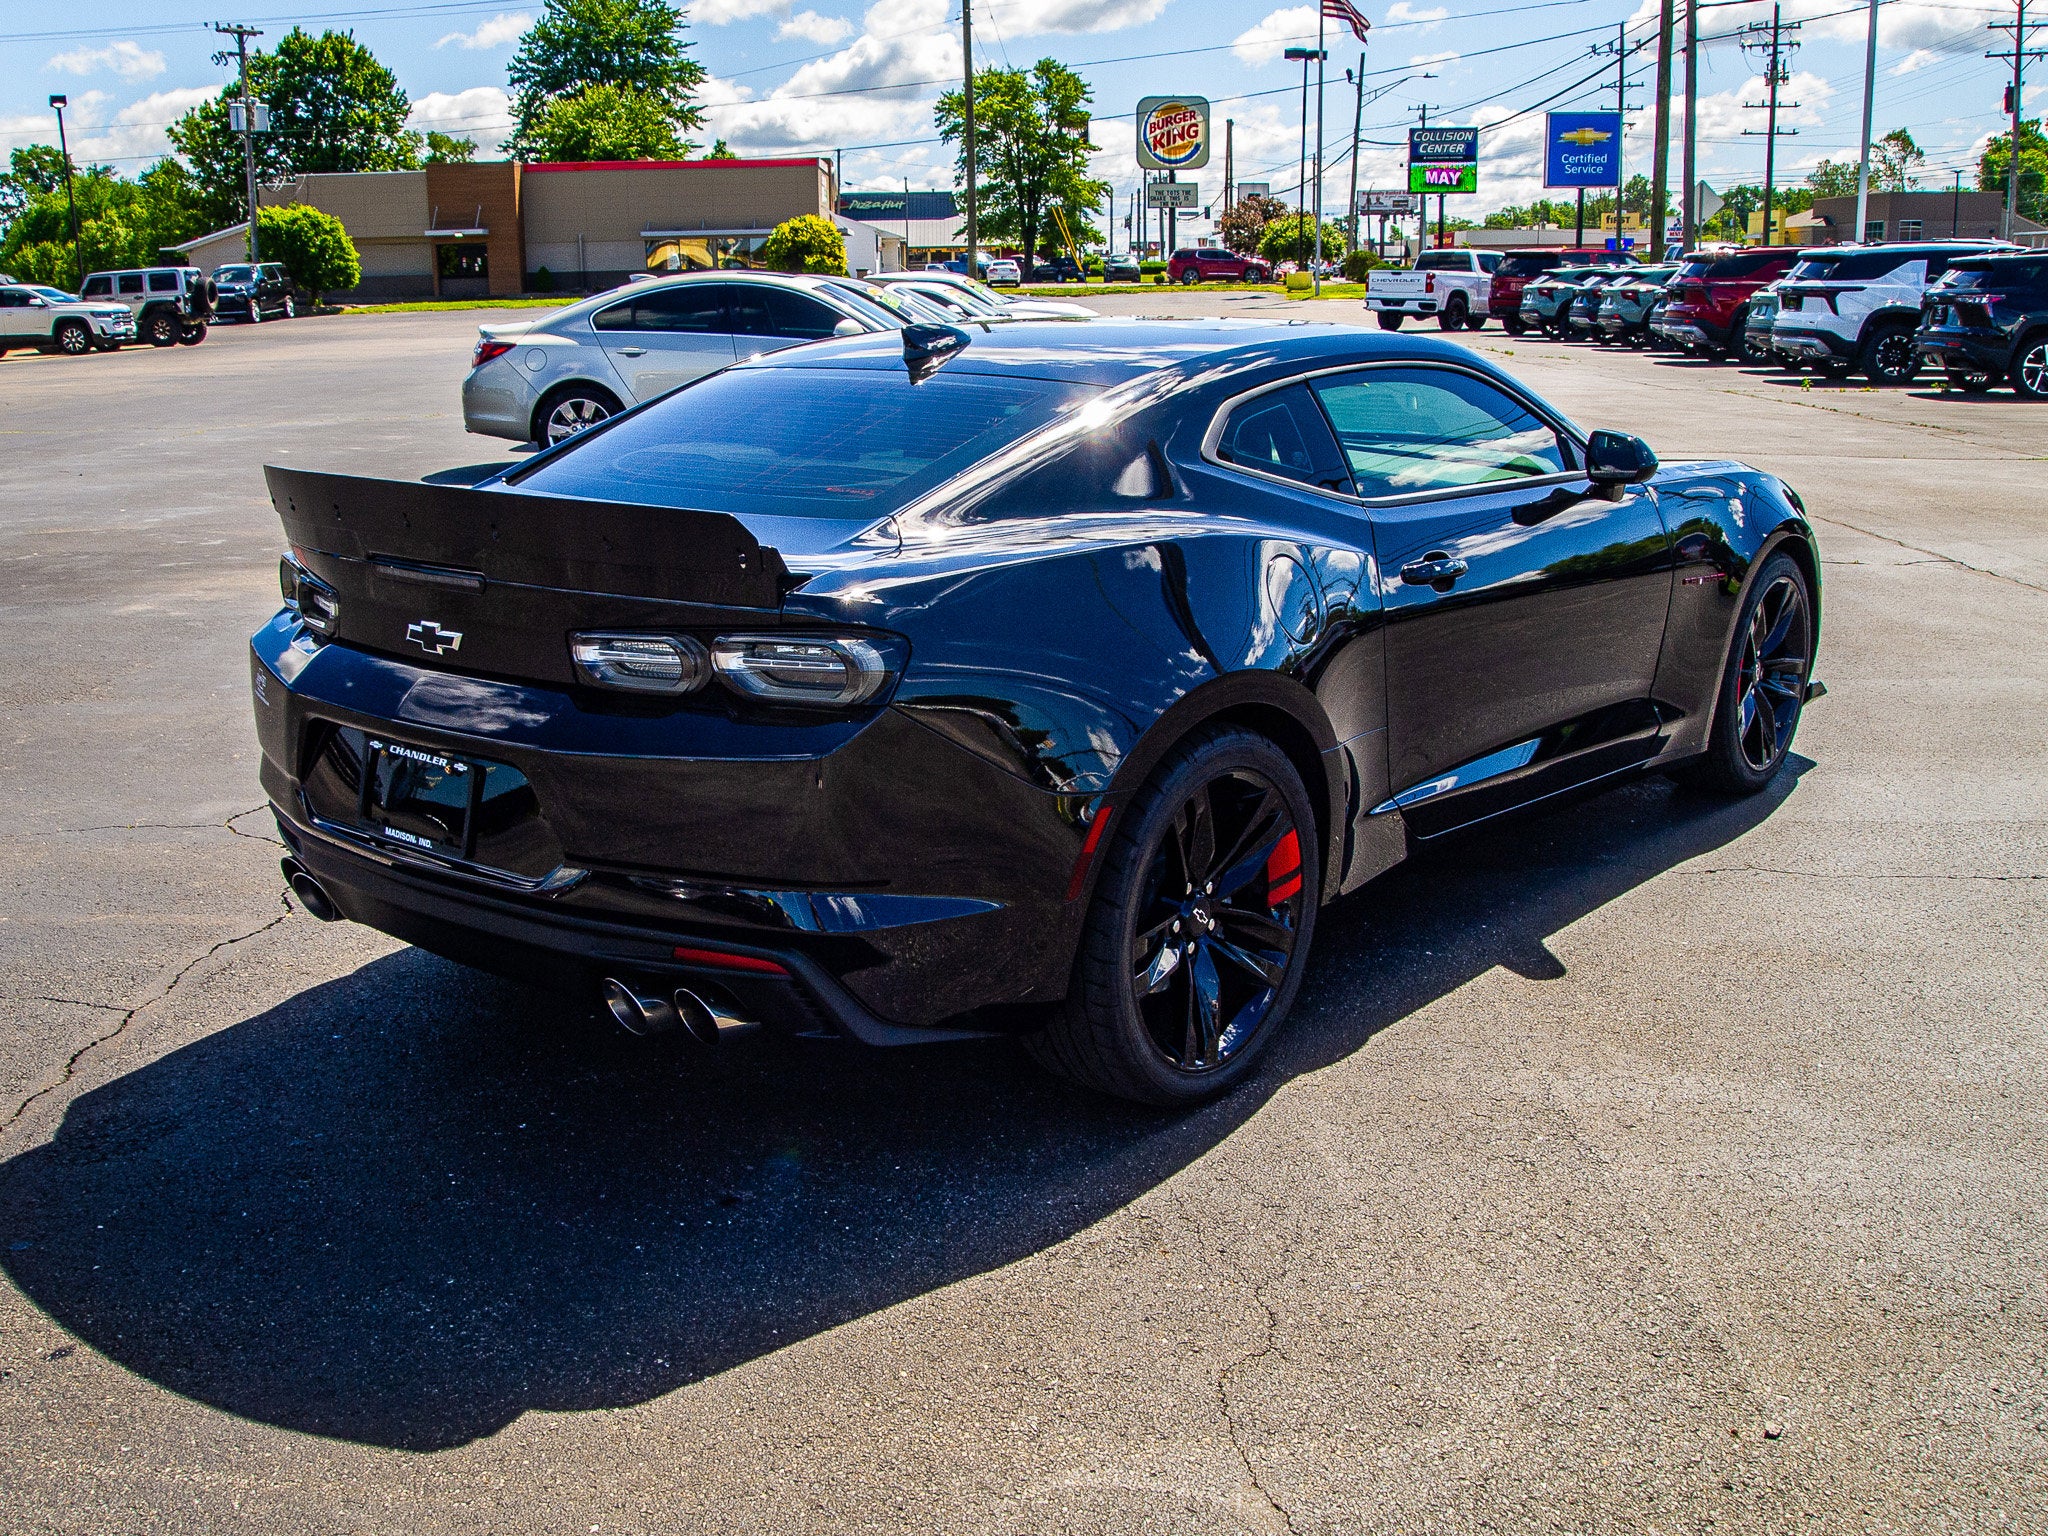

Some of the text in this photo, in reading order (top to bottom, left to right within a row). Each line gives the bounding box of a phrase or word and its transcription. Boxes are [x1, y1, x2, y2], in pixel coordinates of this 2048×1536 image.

[1149, 110, 1197, 135] BURGER
[1152, 123, 1199, 152] KING
[1413, 131, 1474, 141] COLLISION
[1419, 143, 1465, 153] CENTER
[1561, 153, 1608, 164] Certified
[1564, 164, 1604, 174] Service
[1425, 170, 1462, 185] MAY
[848, 200, 906, 210] Pizza Hut
[389, 745, 448, 767] CHANDLER
[418, 837, 433, 849] IND.
